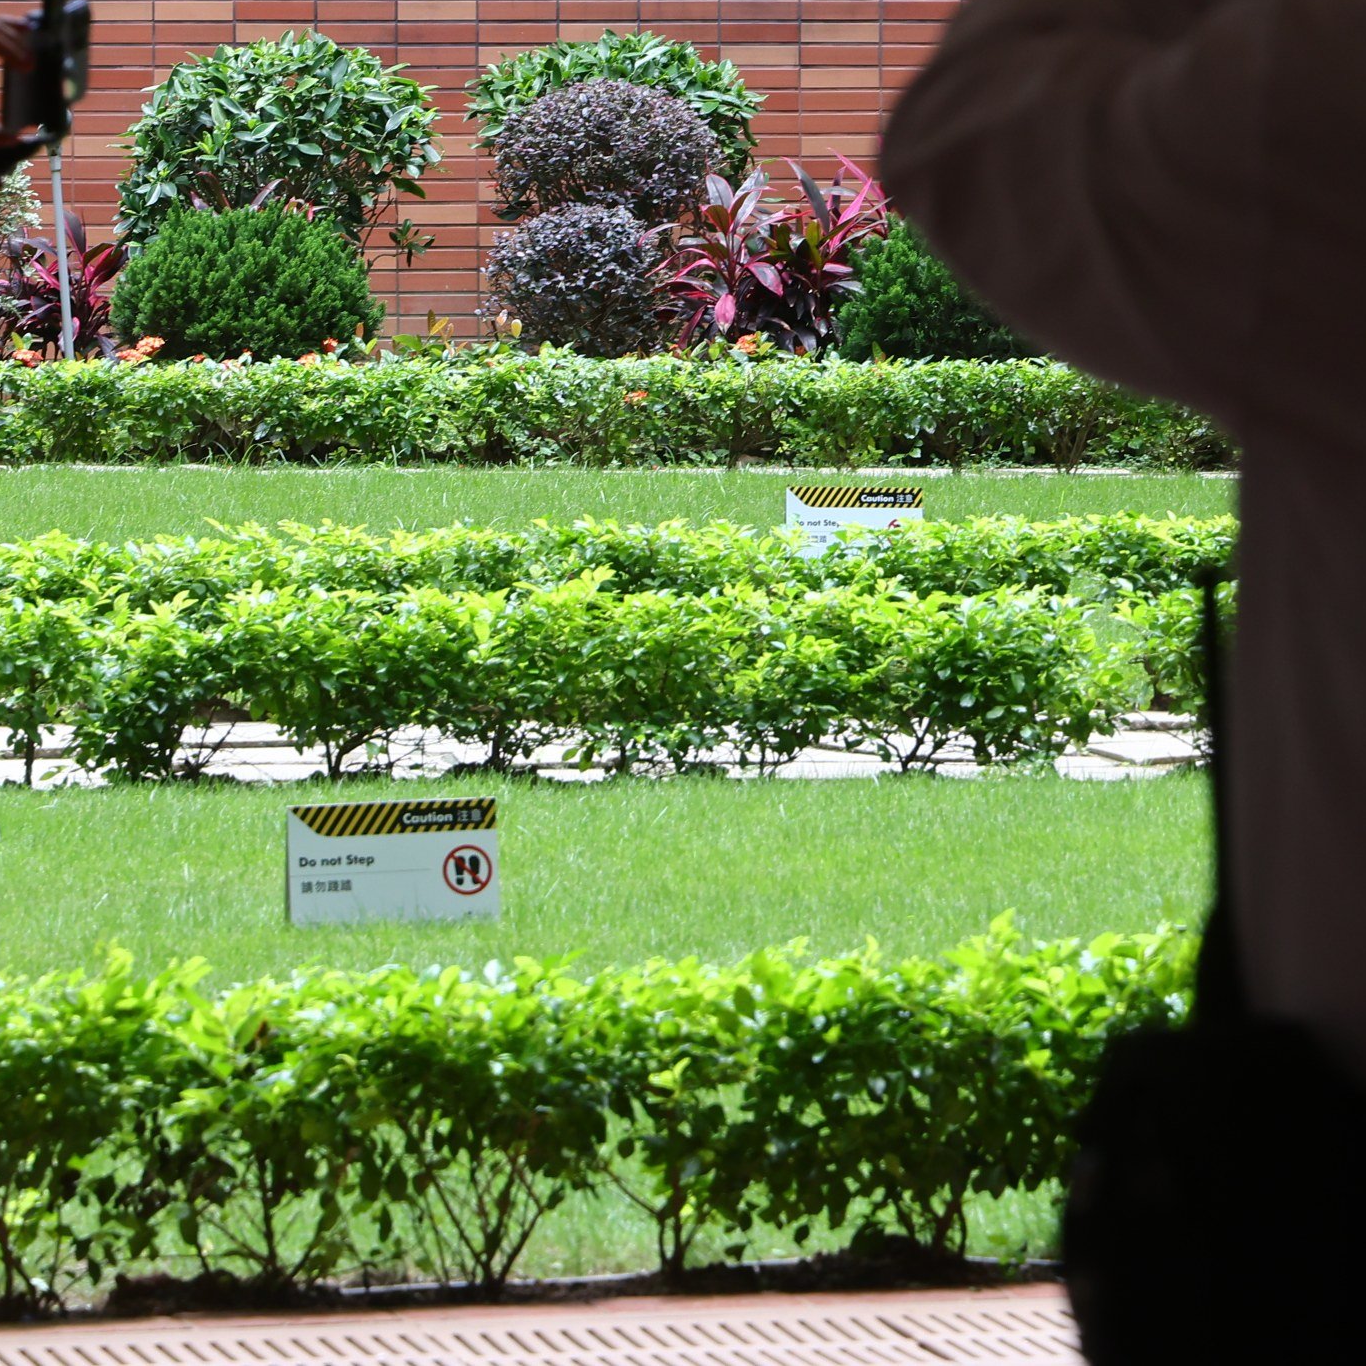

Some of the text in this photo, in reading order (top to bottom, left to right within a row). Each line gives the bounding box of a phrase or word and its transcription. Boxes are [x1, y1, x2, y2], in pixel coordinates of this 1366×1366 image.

[860, 494, 894, 503] Caution
[896, 494, 914, 503] 注意
[402, 811, 453, 824] Caution
[457, 809, 483, 822] 注意
[299, 854, 375, 868] Do not Step
